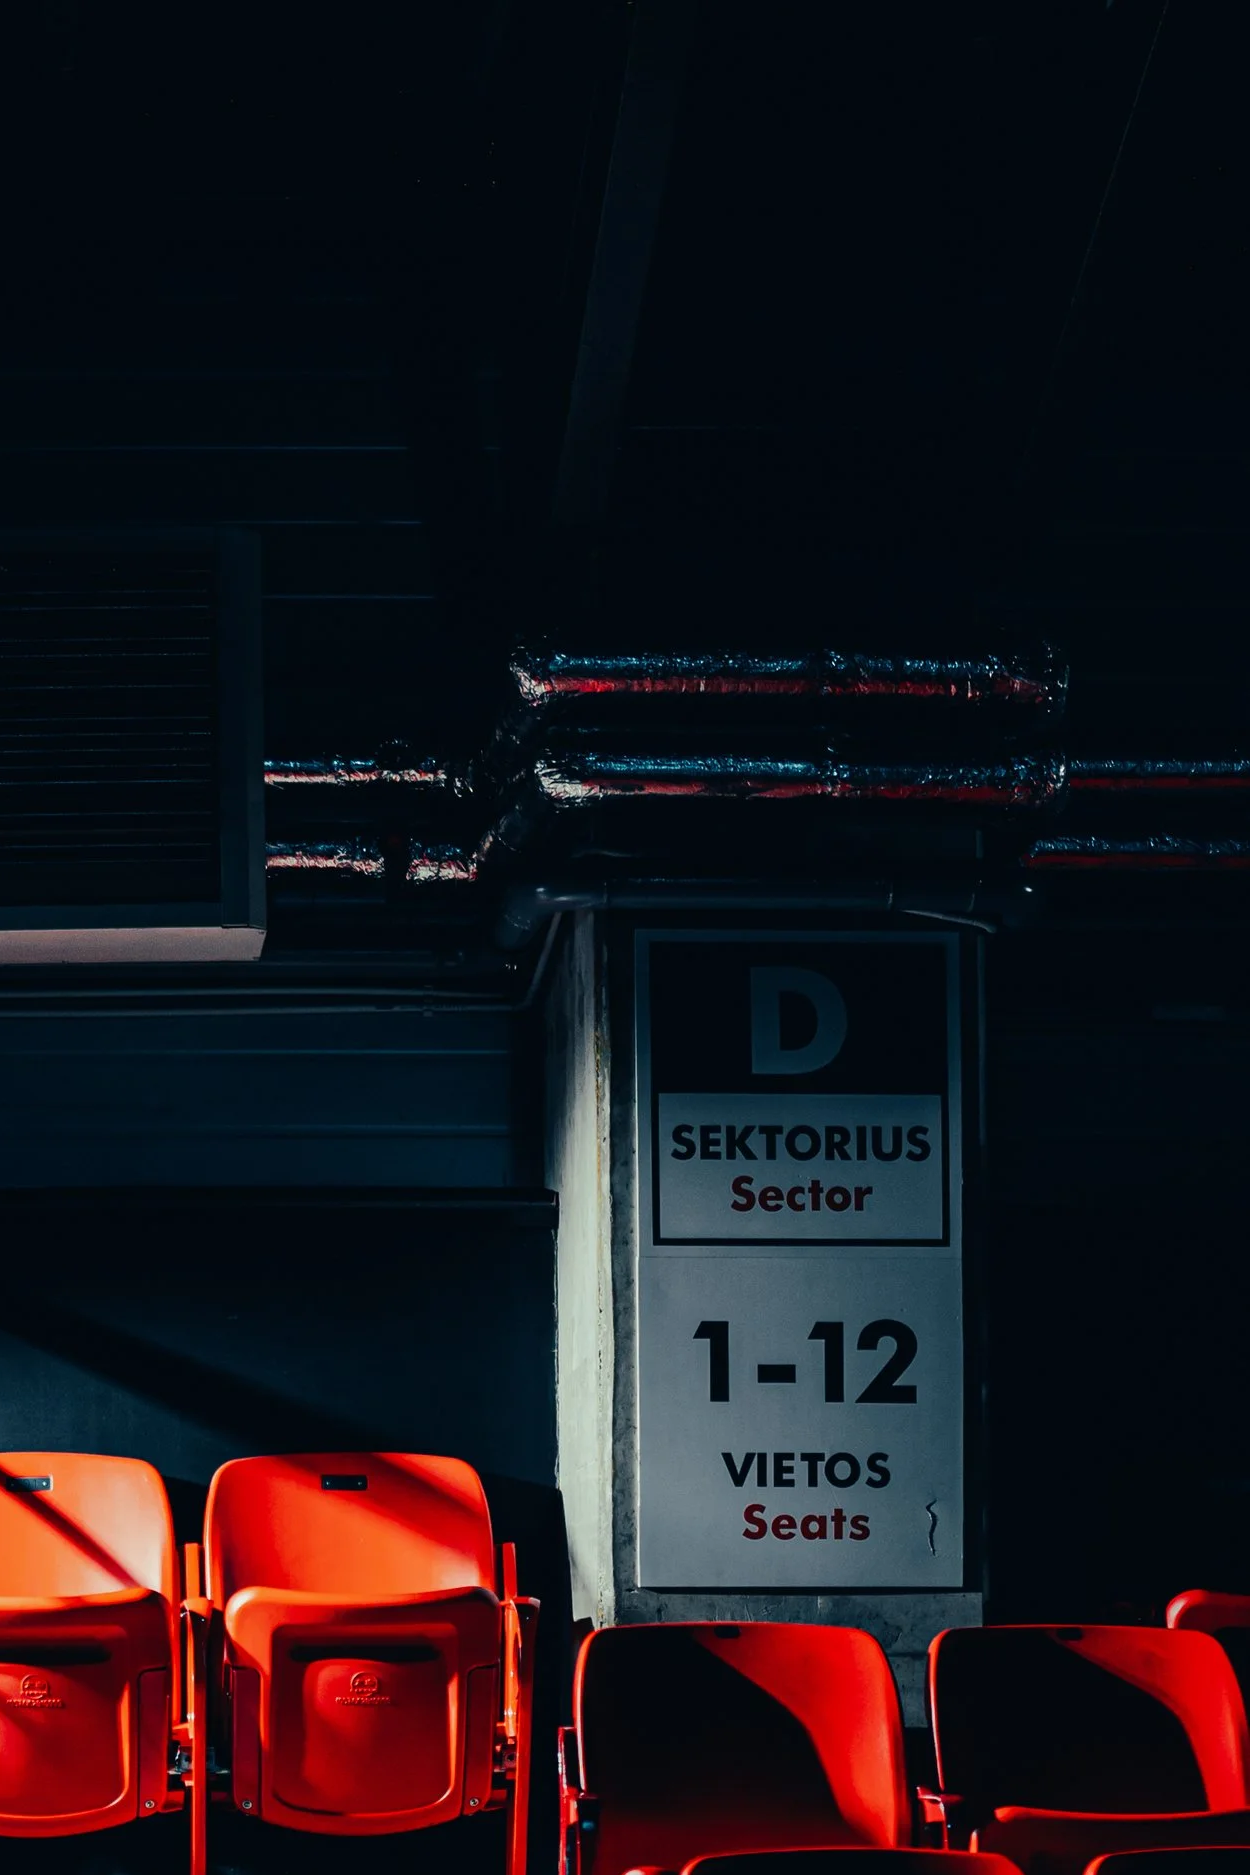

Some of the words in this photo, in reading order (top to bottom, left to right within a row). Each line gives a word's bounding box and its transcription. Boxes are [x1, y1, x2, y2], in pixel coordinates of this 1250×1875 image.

[750, 966, 848, 1075] D
[670, 1123, 932, 1162] SEKTORIUS
[730, 1175, 874, 1212] Sector
[692, 1318, 918, 1405] 1-12
[721, 1451, 891, 1489] VIETOS
[742, 1503, 871, 1541] Seats
